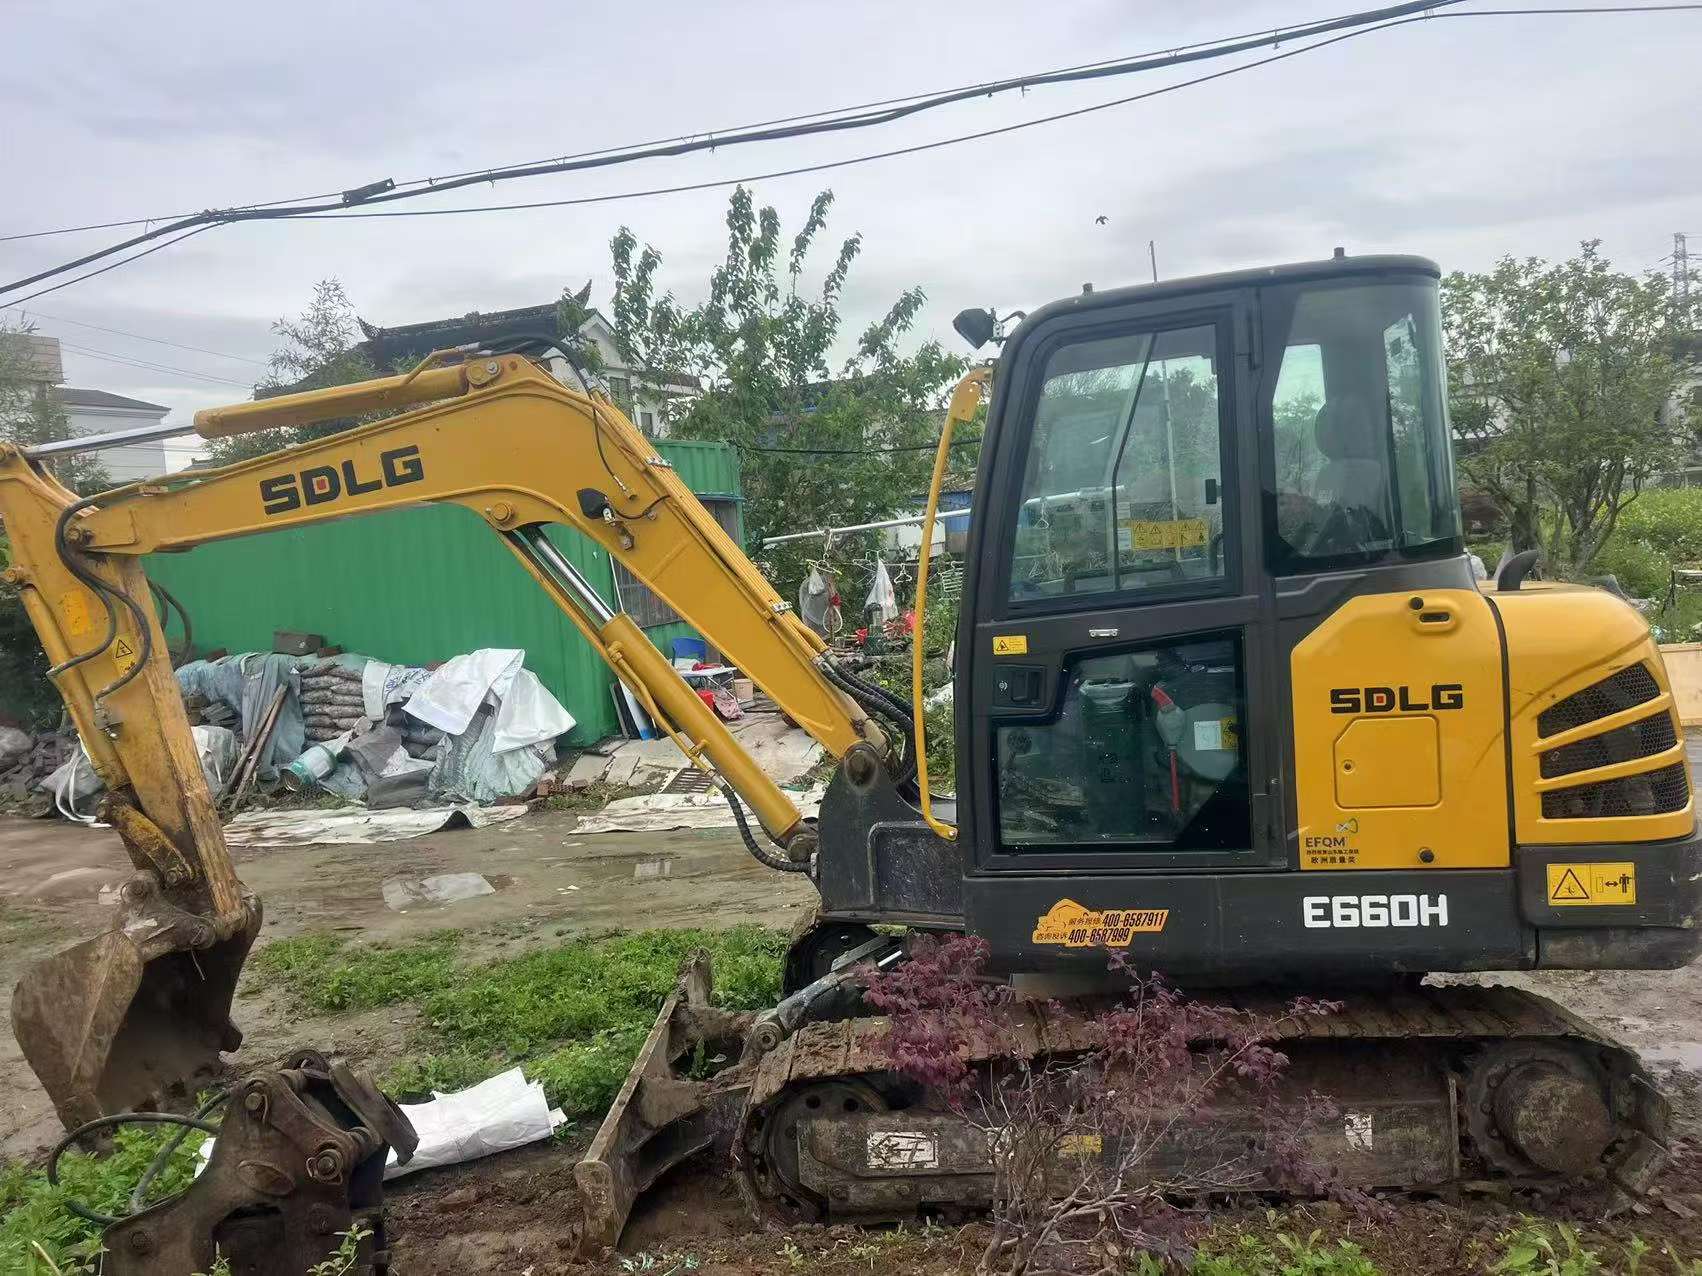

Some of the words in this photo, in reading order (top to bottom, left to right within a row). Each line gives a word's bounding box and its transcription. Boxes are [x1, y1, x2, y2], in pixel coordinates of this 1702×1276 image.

[260, 444, 424, 516] SDLG
[1330, 684, 1463, 713] SDLG
[1305, 837, 1346, 848] EFQM
[1102, 912, 1165, 928] 400-6587911
[1303, 894, 1448, 928] E660H
